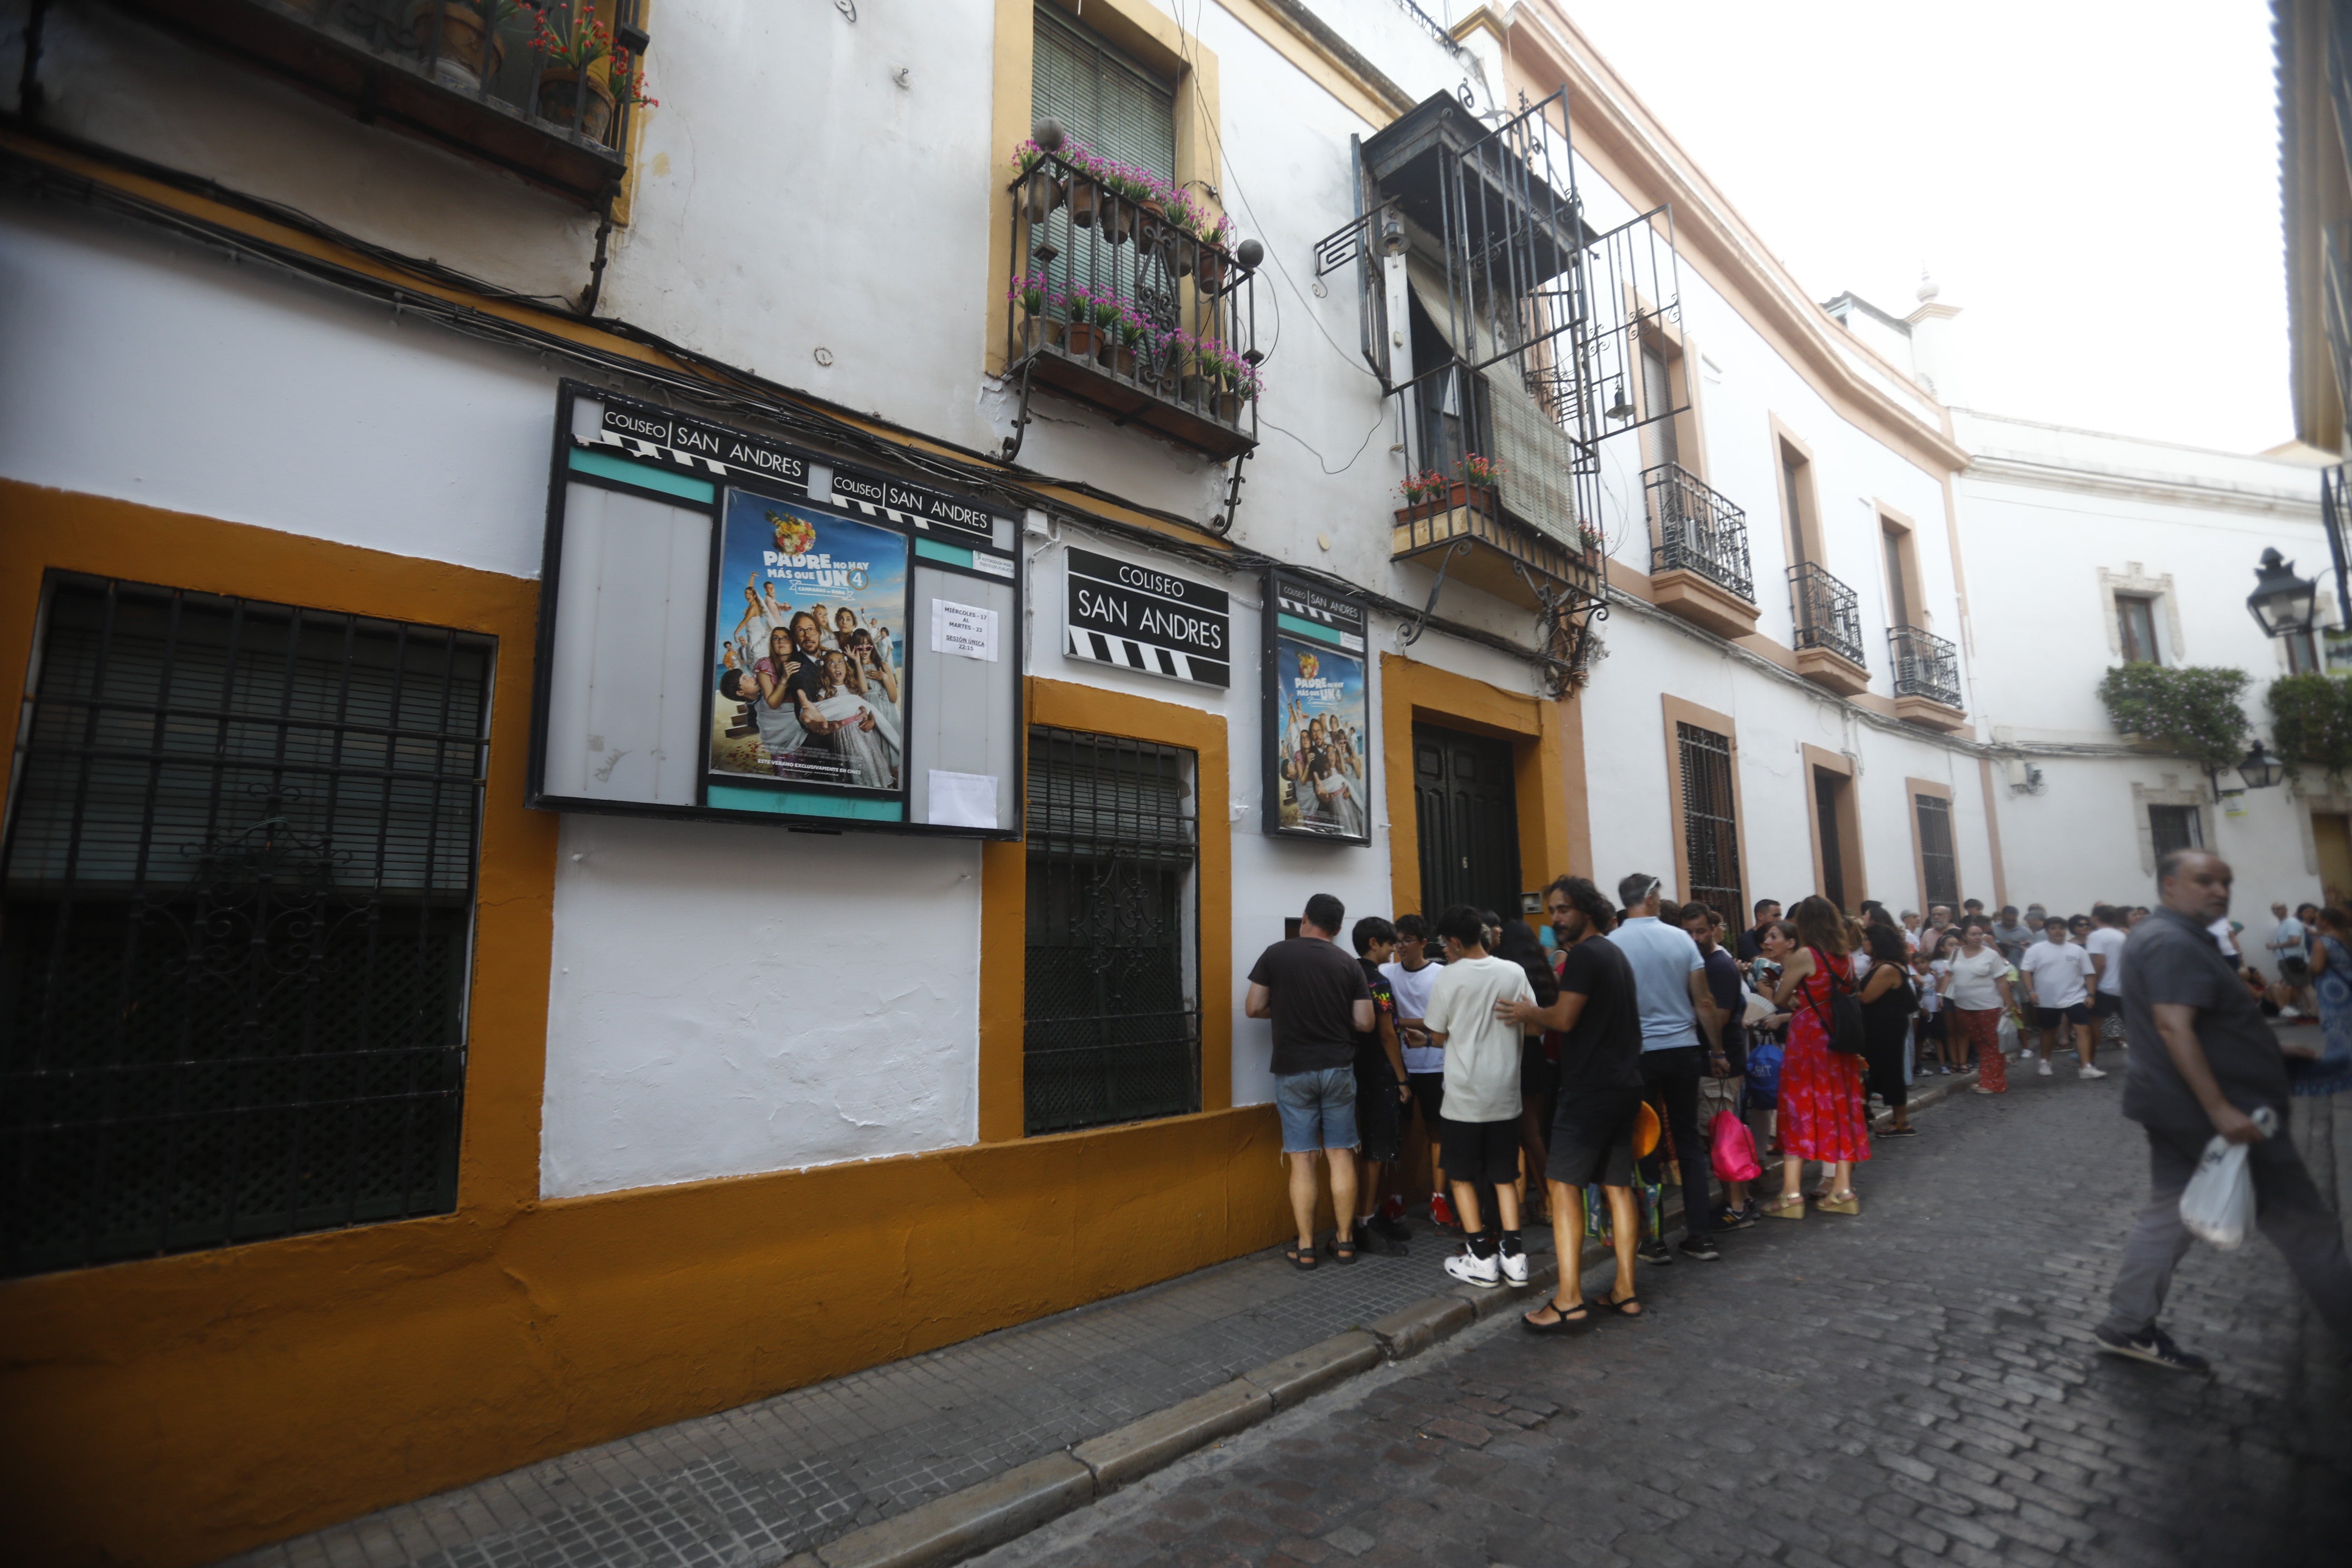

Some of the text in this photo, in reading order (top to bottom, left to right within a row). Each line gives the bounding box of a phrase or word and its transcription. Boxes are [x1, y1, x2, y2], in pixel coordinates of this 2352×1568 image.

[605, 411, 801, 476] COLISEO SAN ANDRES
[834, 477, 987, 528] COLISEO SAN ANDRES
[763, 551, 831, 569] PADRE
[848, 562, 869, 570] HAY
[767, 567, 792, 579] MÁS
[794, 571, 815, 580] QUE
[852, 572, 863, 586] 4
[1119, 566, 1184, 597] COLISEO
[945, 607, 975, 618] MIÉRCOLES
[1311, 594, 1327, 607] SAN
[1330, 602, 1358, 618] ANDRES
[949, 622, 971, 630] MARTES
[1079, 590, 1221, 649] SAN ANDRES
[946, 635, 985, 647] SESIÓN ÚNICA
[1295, 677, 1327, 689] PADRE
